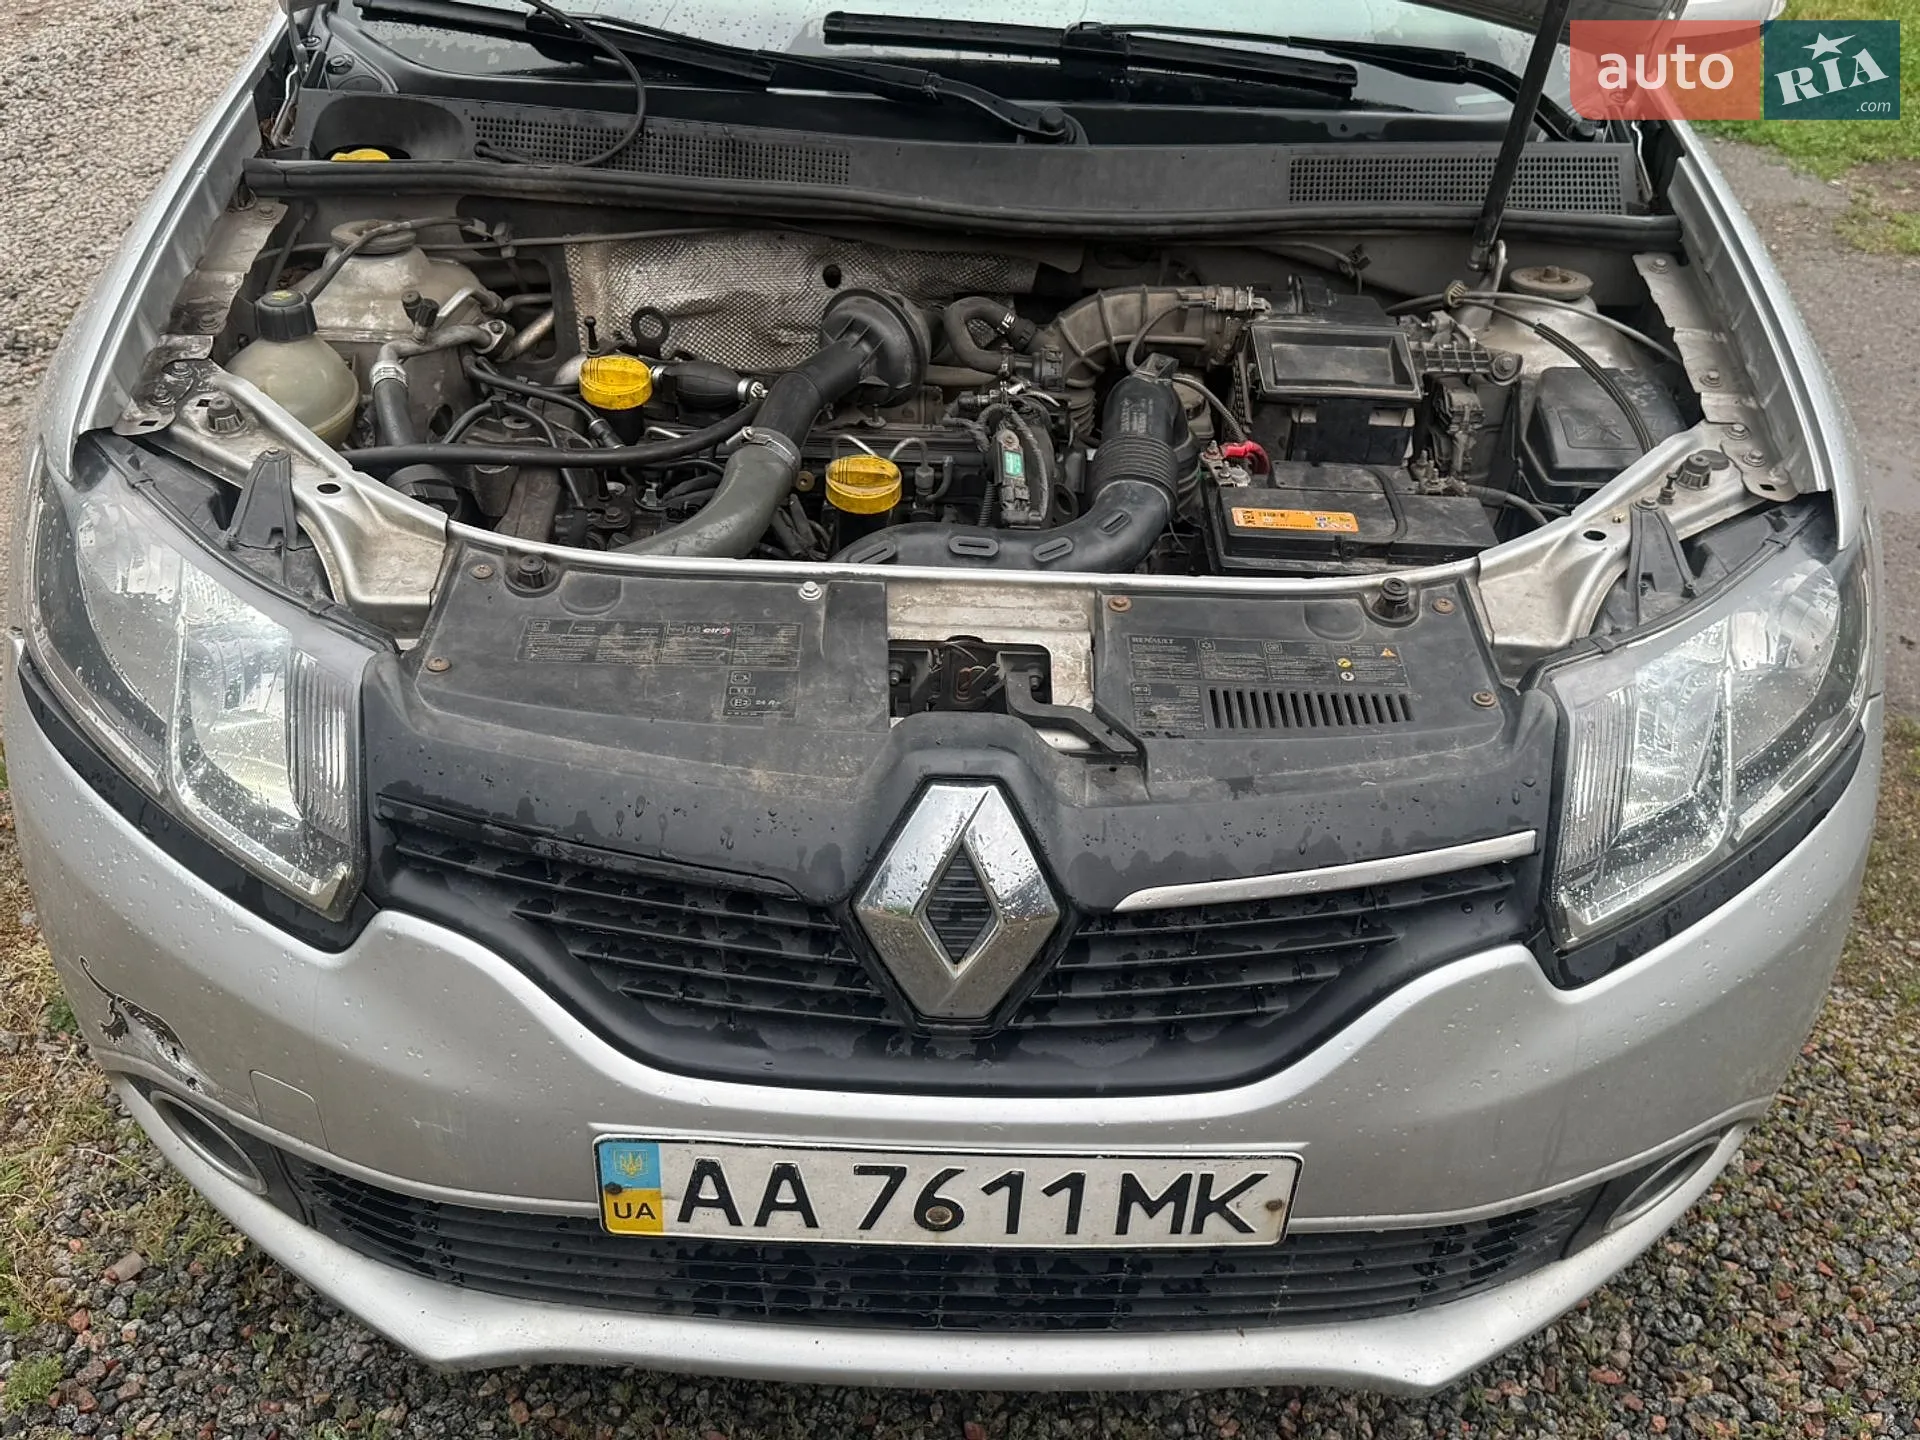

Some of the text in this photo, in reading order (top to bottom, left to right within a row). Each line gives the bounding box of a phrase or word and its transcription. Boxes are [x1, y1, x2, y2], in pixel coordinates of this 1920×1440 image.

[613, 1202, 657, 1220] UA
[677, 1158, 1269, 1235] AA 7611 MK
